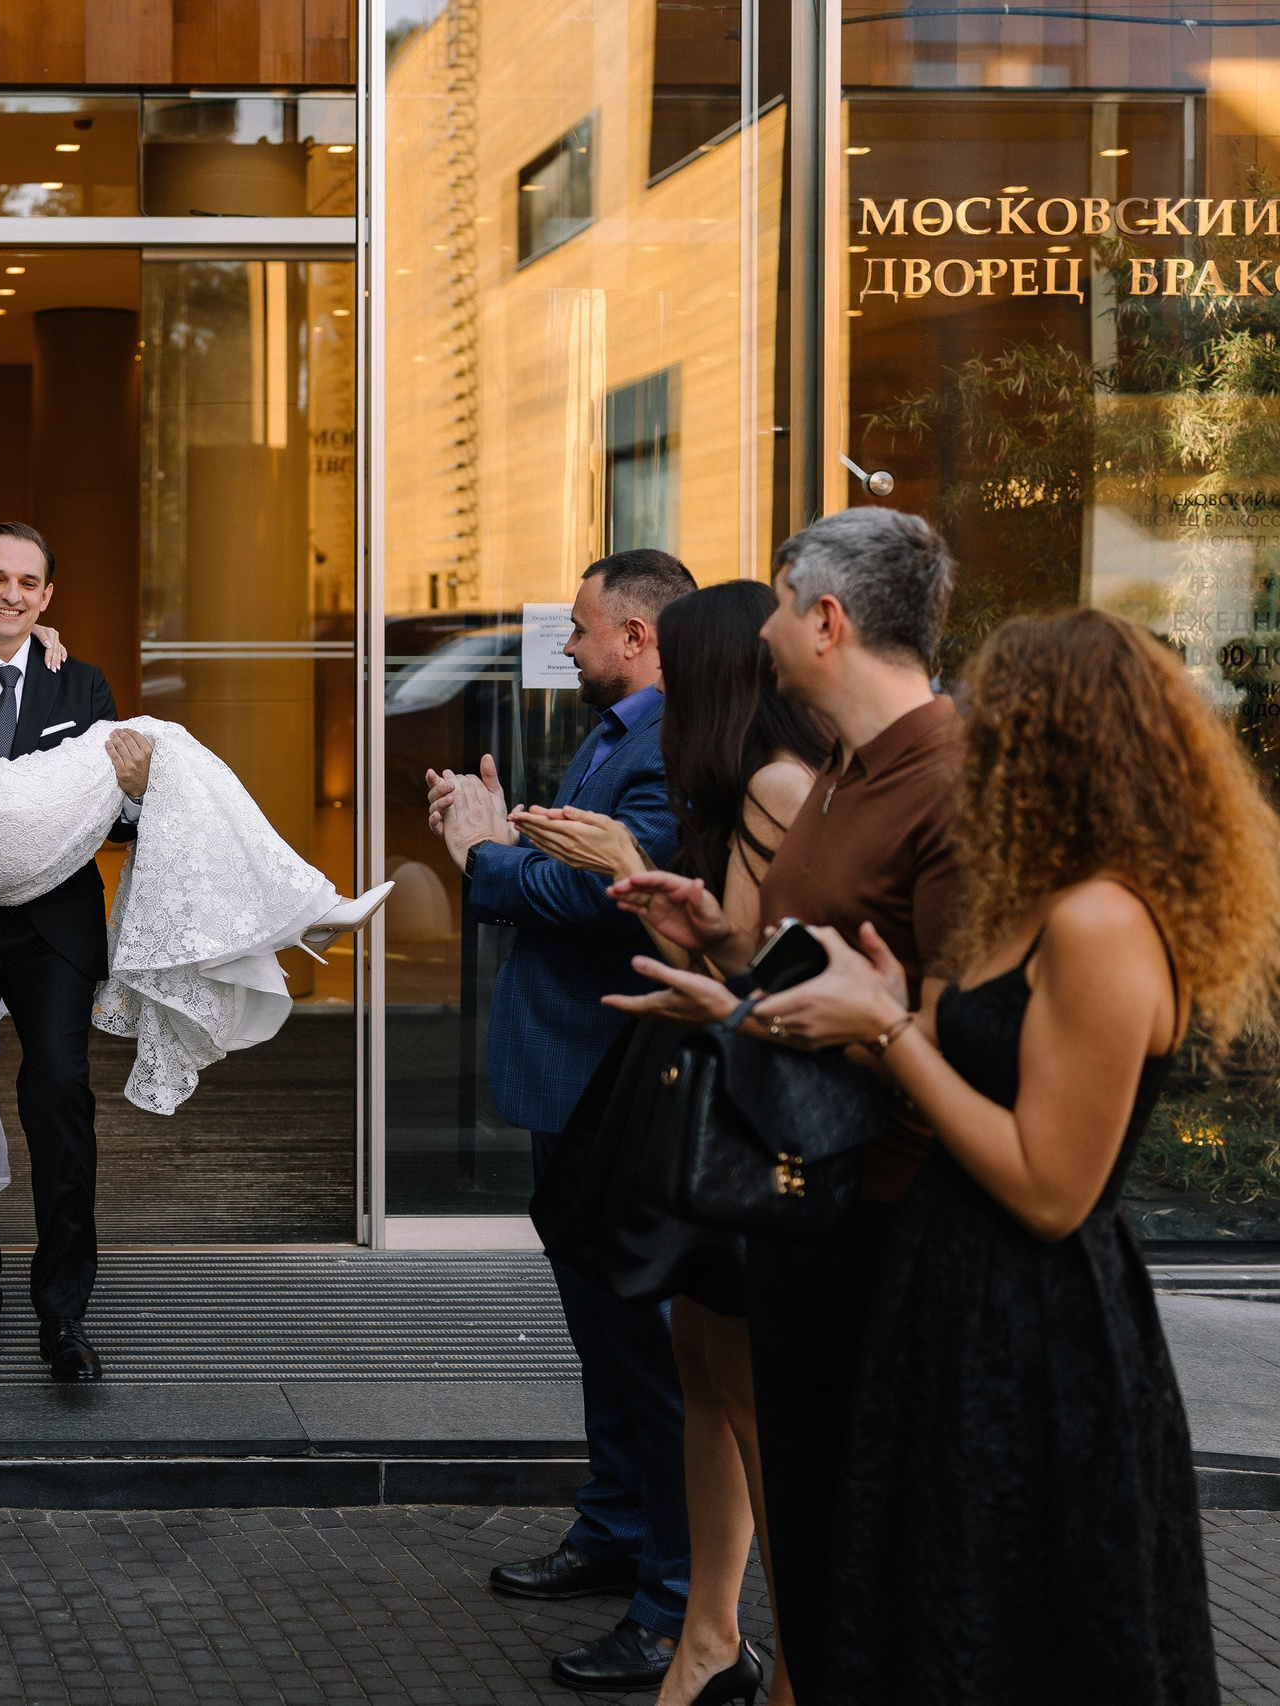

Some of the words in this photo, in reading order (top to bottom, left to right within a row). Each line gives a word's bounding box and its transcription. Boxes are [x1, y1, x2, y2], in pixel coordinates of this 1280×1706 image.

[859, 257, 1084, 304] ДВОРЕЦ
[1129, 257, 1280, 297] БРАК
[1144, 491, 1267, 507] МОСКОВСКИЙ
[1131, 514, 1199, 528] ДВОРЕЦ
[1211, 535, 1266, 548] ОТДЕЛ
[1191, 576, 1253, 589] РЕЖИМ
